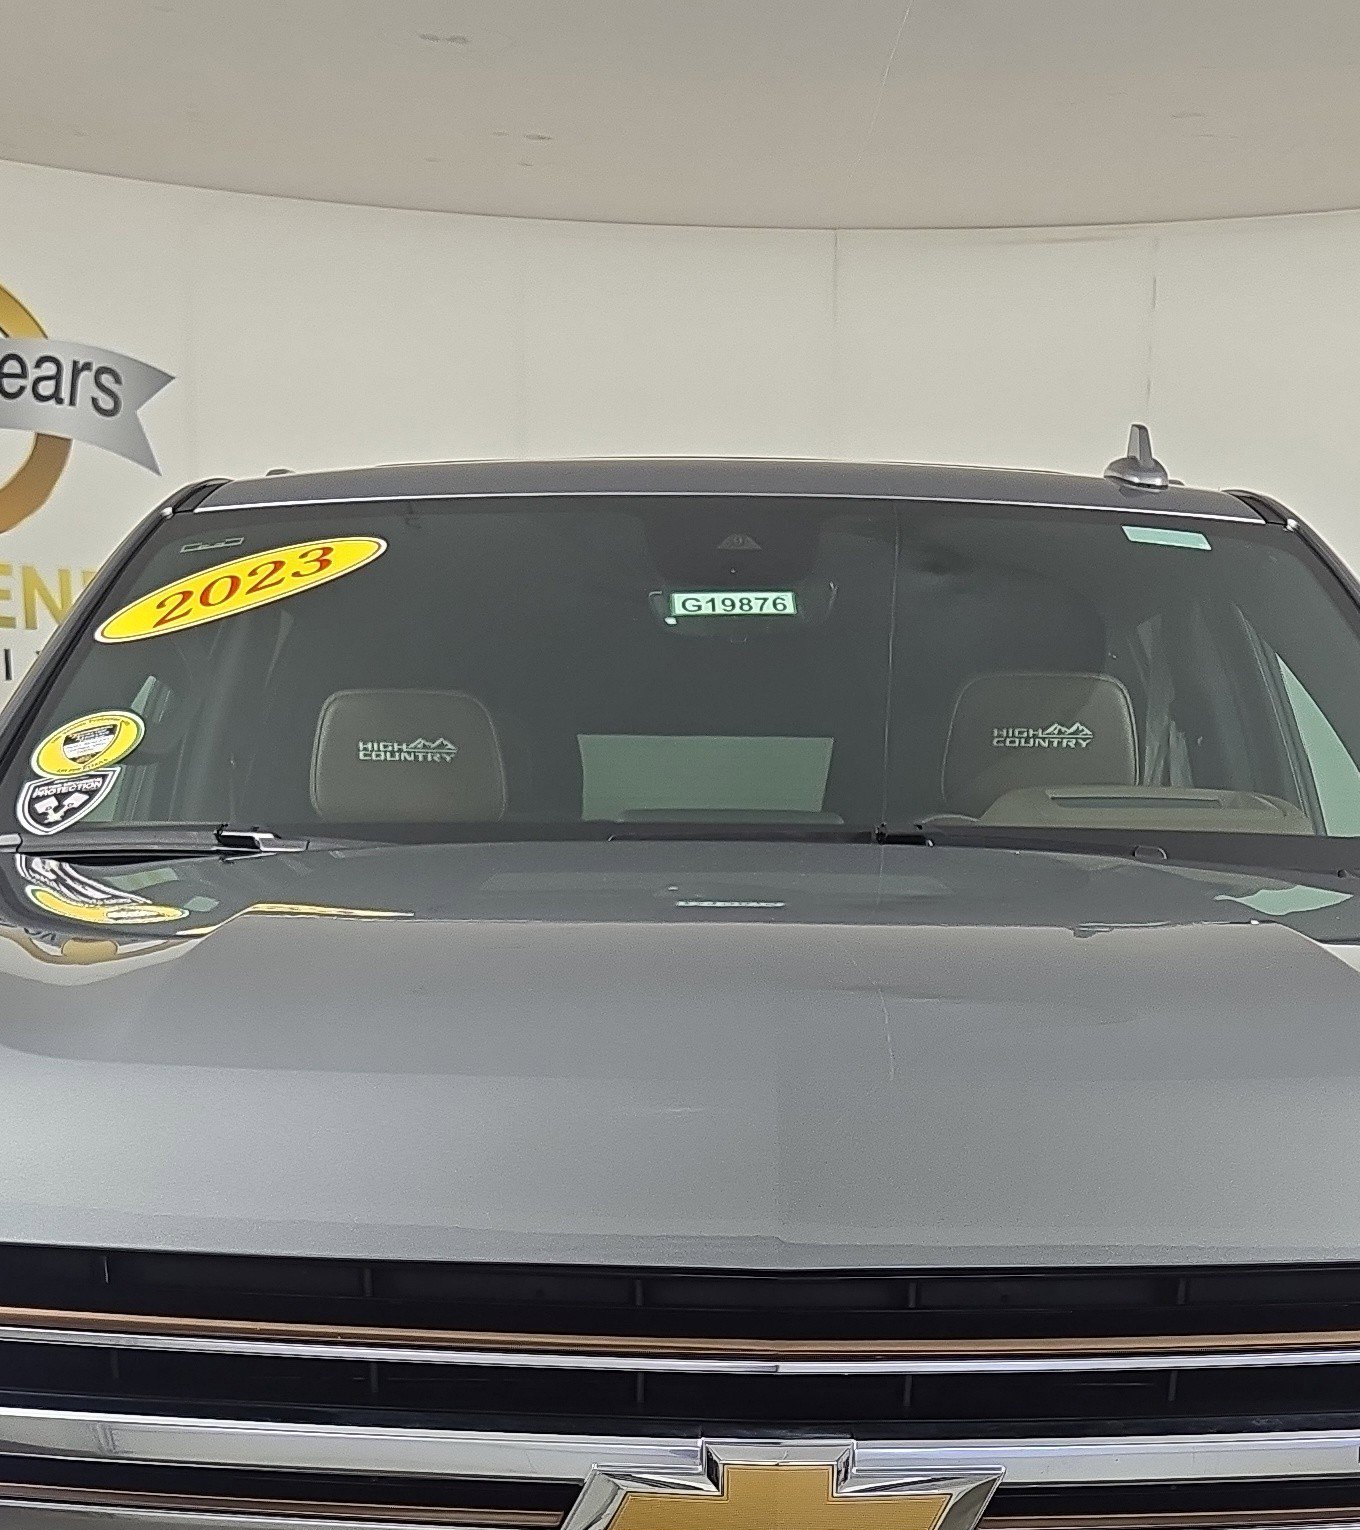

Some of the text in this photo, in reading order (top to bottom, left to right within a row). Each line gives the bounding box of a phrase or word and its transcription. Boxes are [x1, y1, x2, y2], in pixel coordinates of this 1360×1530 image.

[152, 547, 335, 629] 2023
[680, 597, 788, 613] G19876
[992, 727, 1043, 738] HIGH
[358, 740, 407, 751] HIGH
[992, 738, 1092, 748] COUNTRY
[358, 751, 456, 762] COUNTRY
